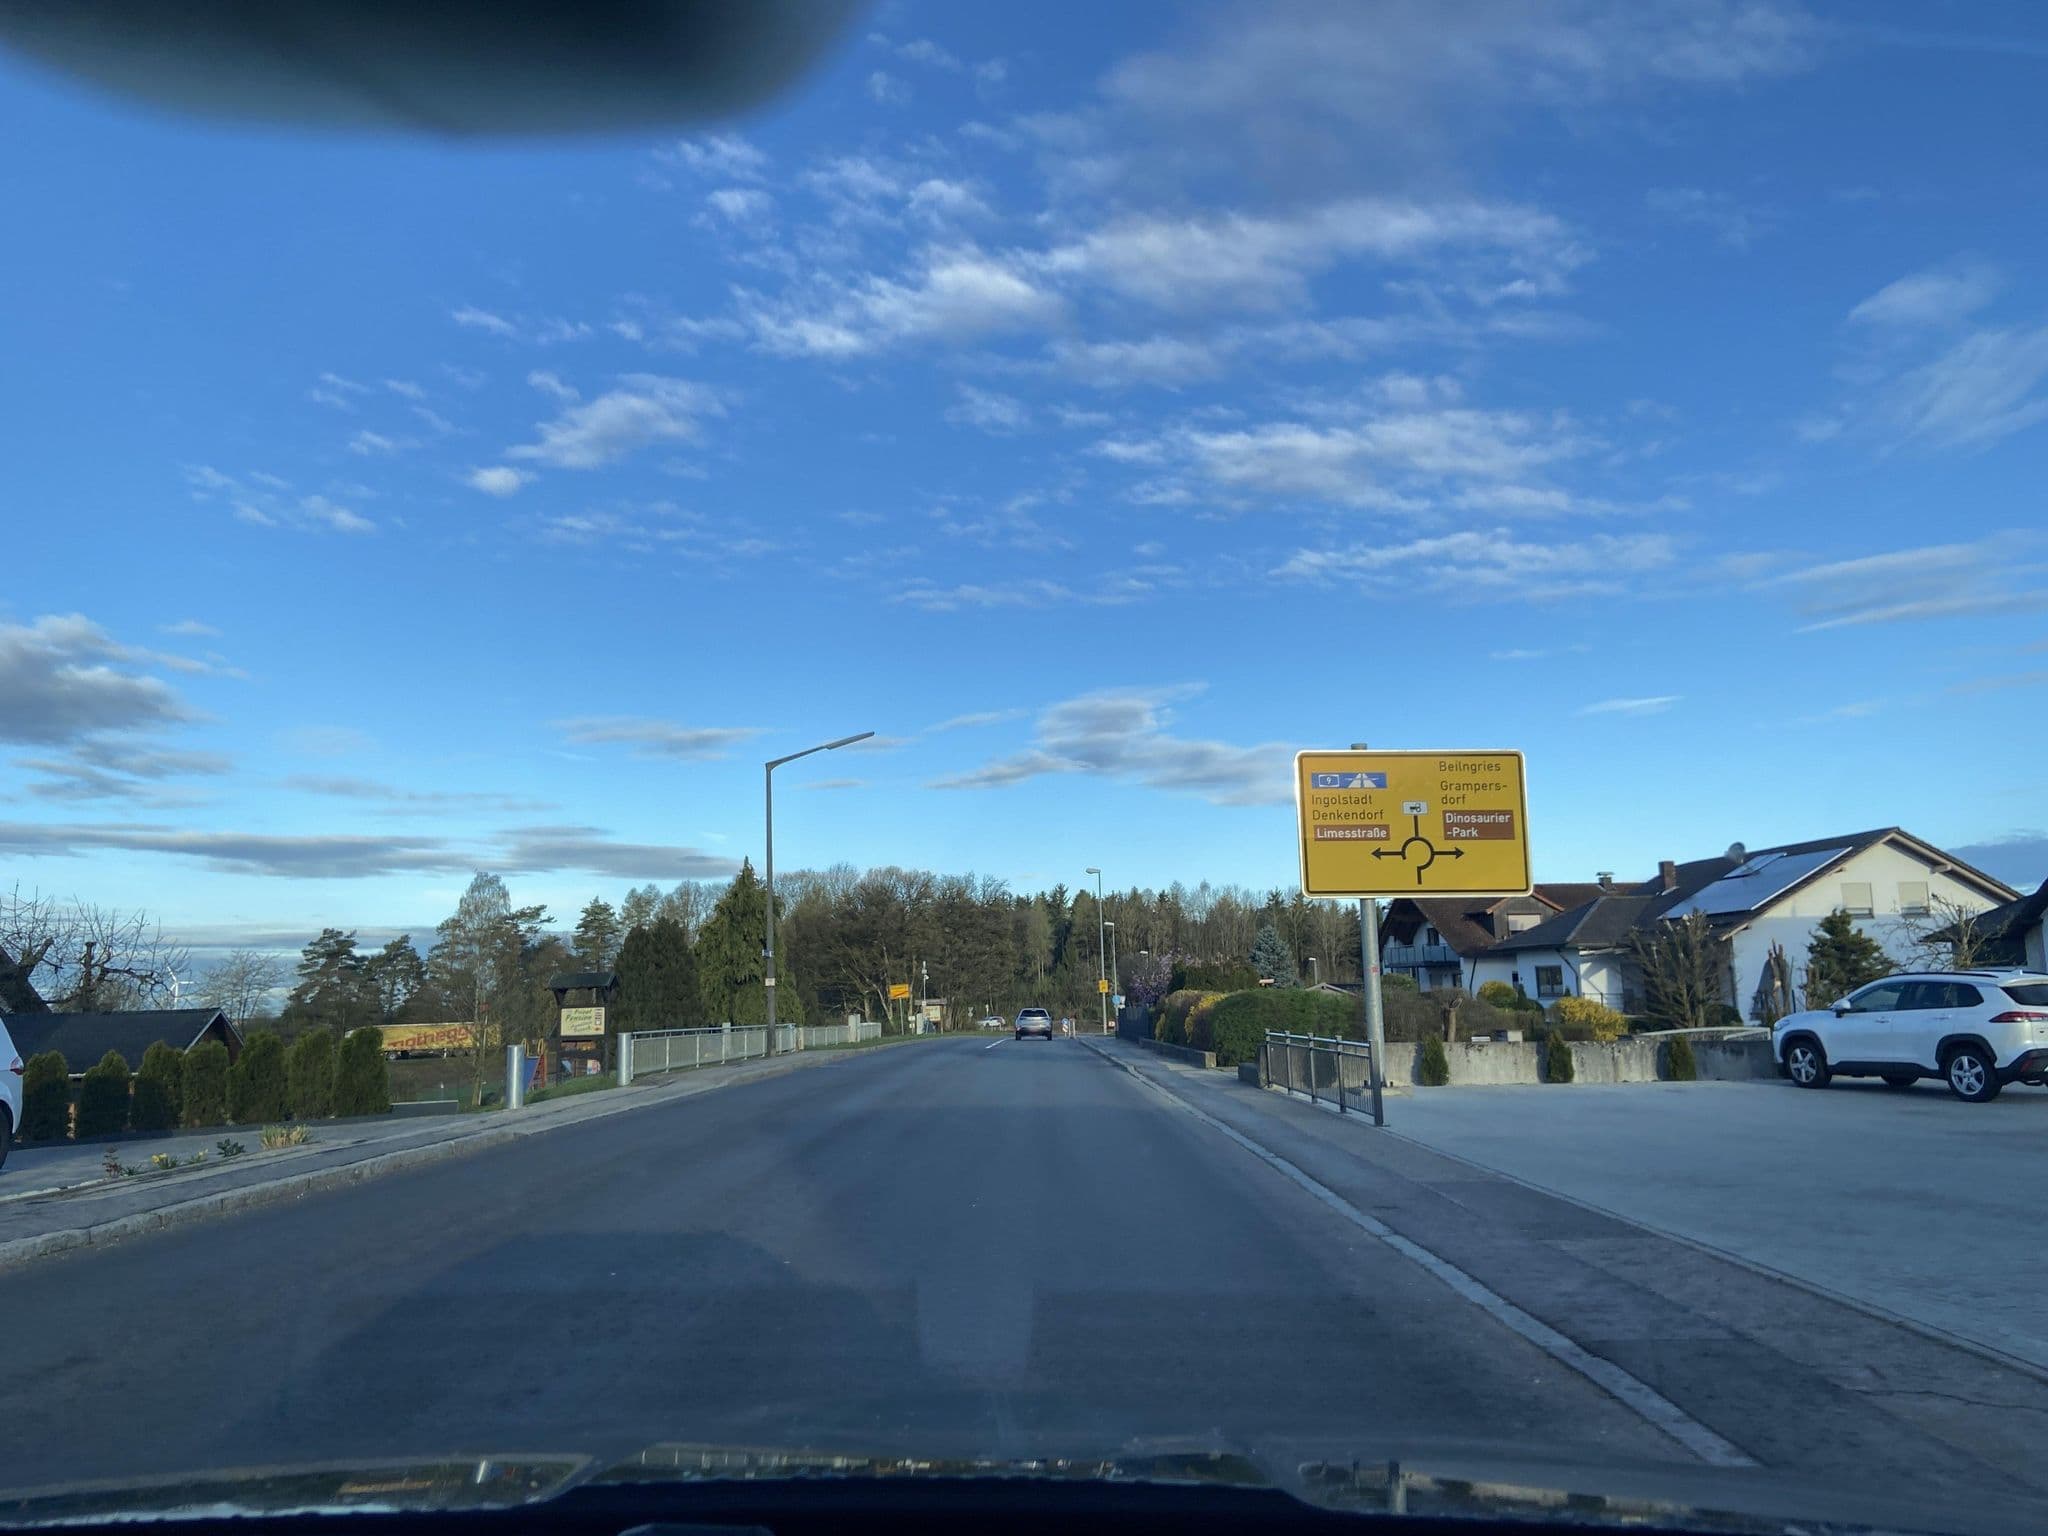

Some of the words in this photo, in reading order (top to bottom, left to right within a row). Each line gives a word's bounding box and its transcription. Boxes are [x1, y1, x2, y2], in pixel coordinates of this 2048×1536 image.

[1439, 761, 1501, 774] Beilngries
[1326, 776, 1332, 785] 9
[1440, 780, 1508, 793] Grampers-
[1311, 794, 1373, 808] Ingolstadt
[1441, 794, 1467, 805] dorf
[1312, 809, 1385, 821] Denkendorf
[1445, 812, 1512, 824] Dinosaurier
[1316, 827, 1387, 839] Limesstraße
[1447, 826, 1479, 839] -Park
